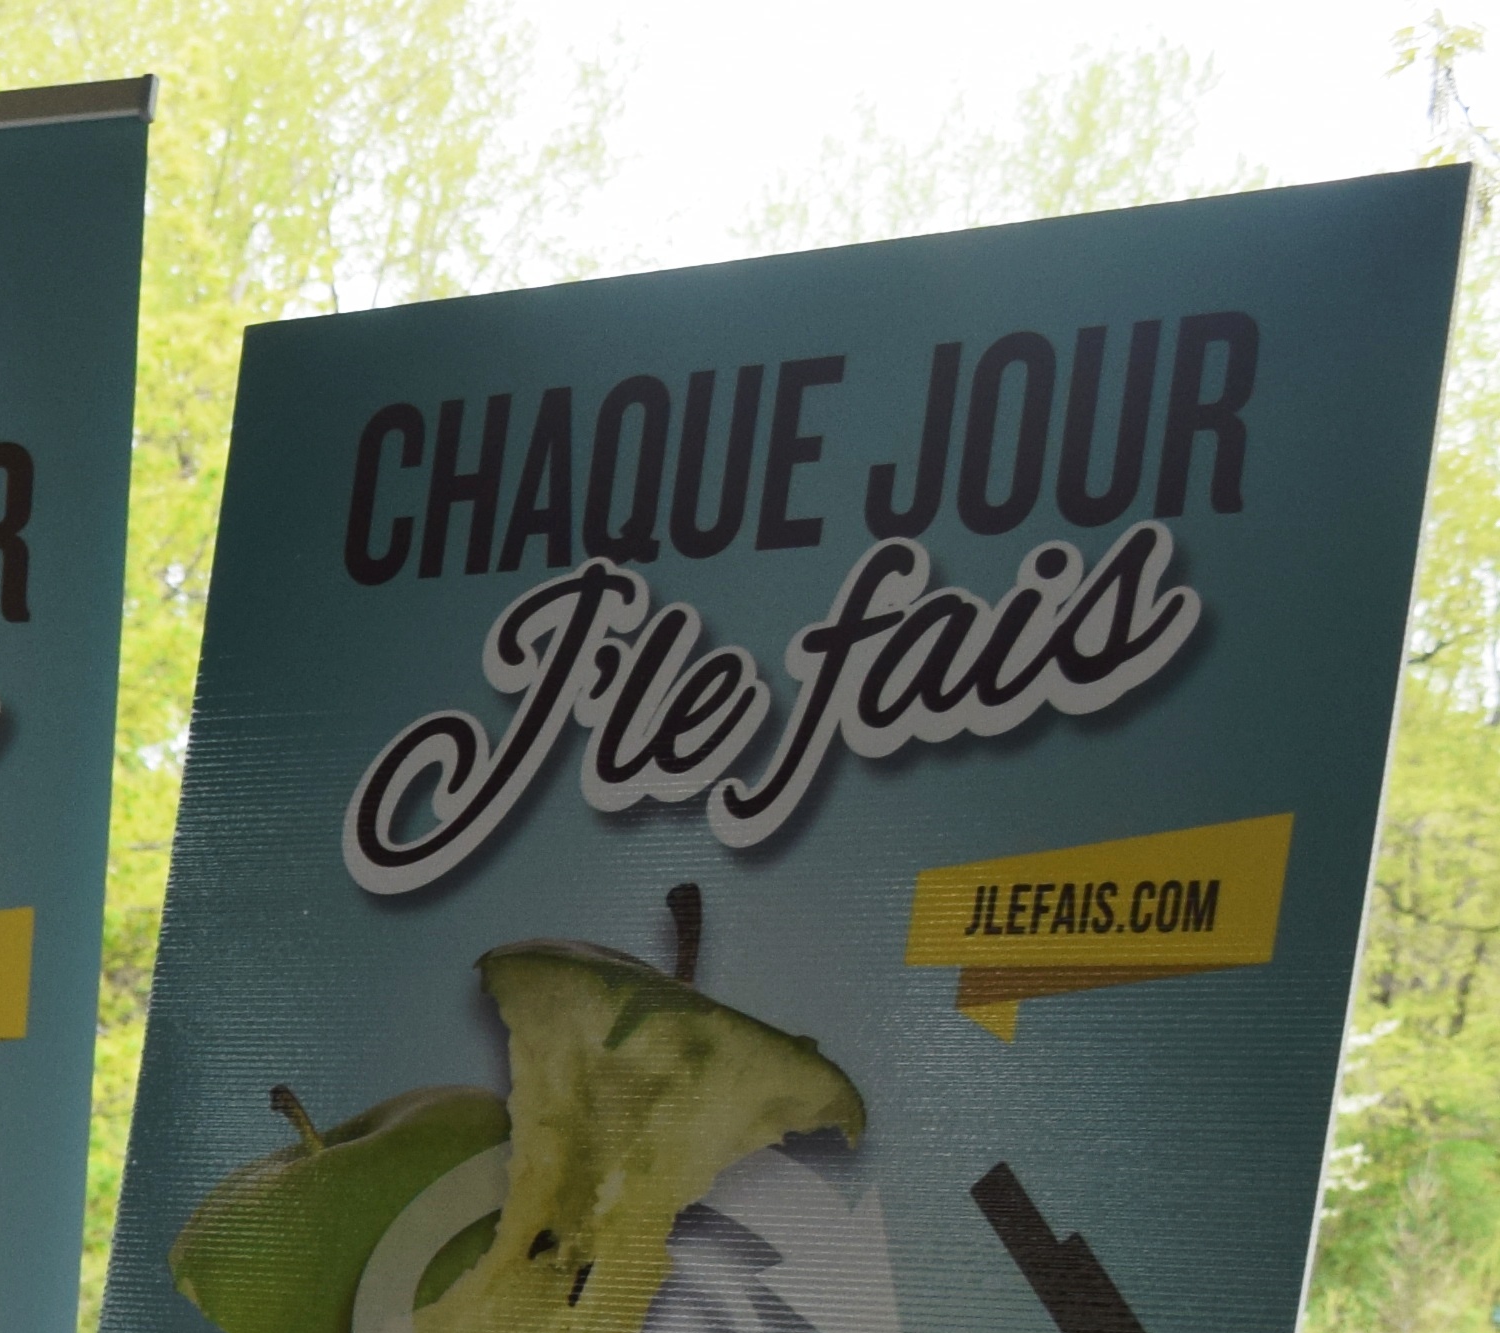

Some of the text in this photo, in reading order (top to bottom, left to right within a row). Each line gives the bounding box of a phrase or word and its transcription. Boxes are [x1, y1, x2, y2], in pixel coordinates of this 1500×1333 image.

[343, 311, 1260, 586] CHAQUE JOUR
[720, 520, 1186, 822] fais
[965, 880, 1219, 938] JLEFAIS.COM
